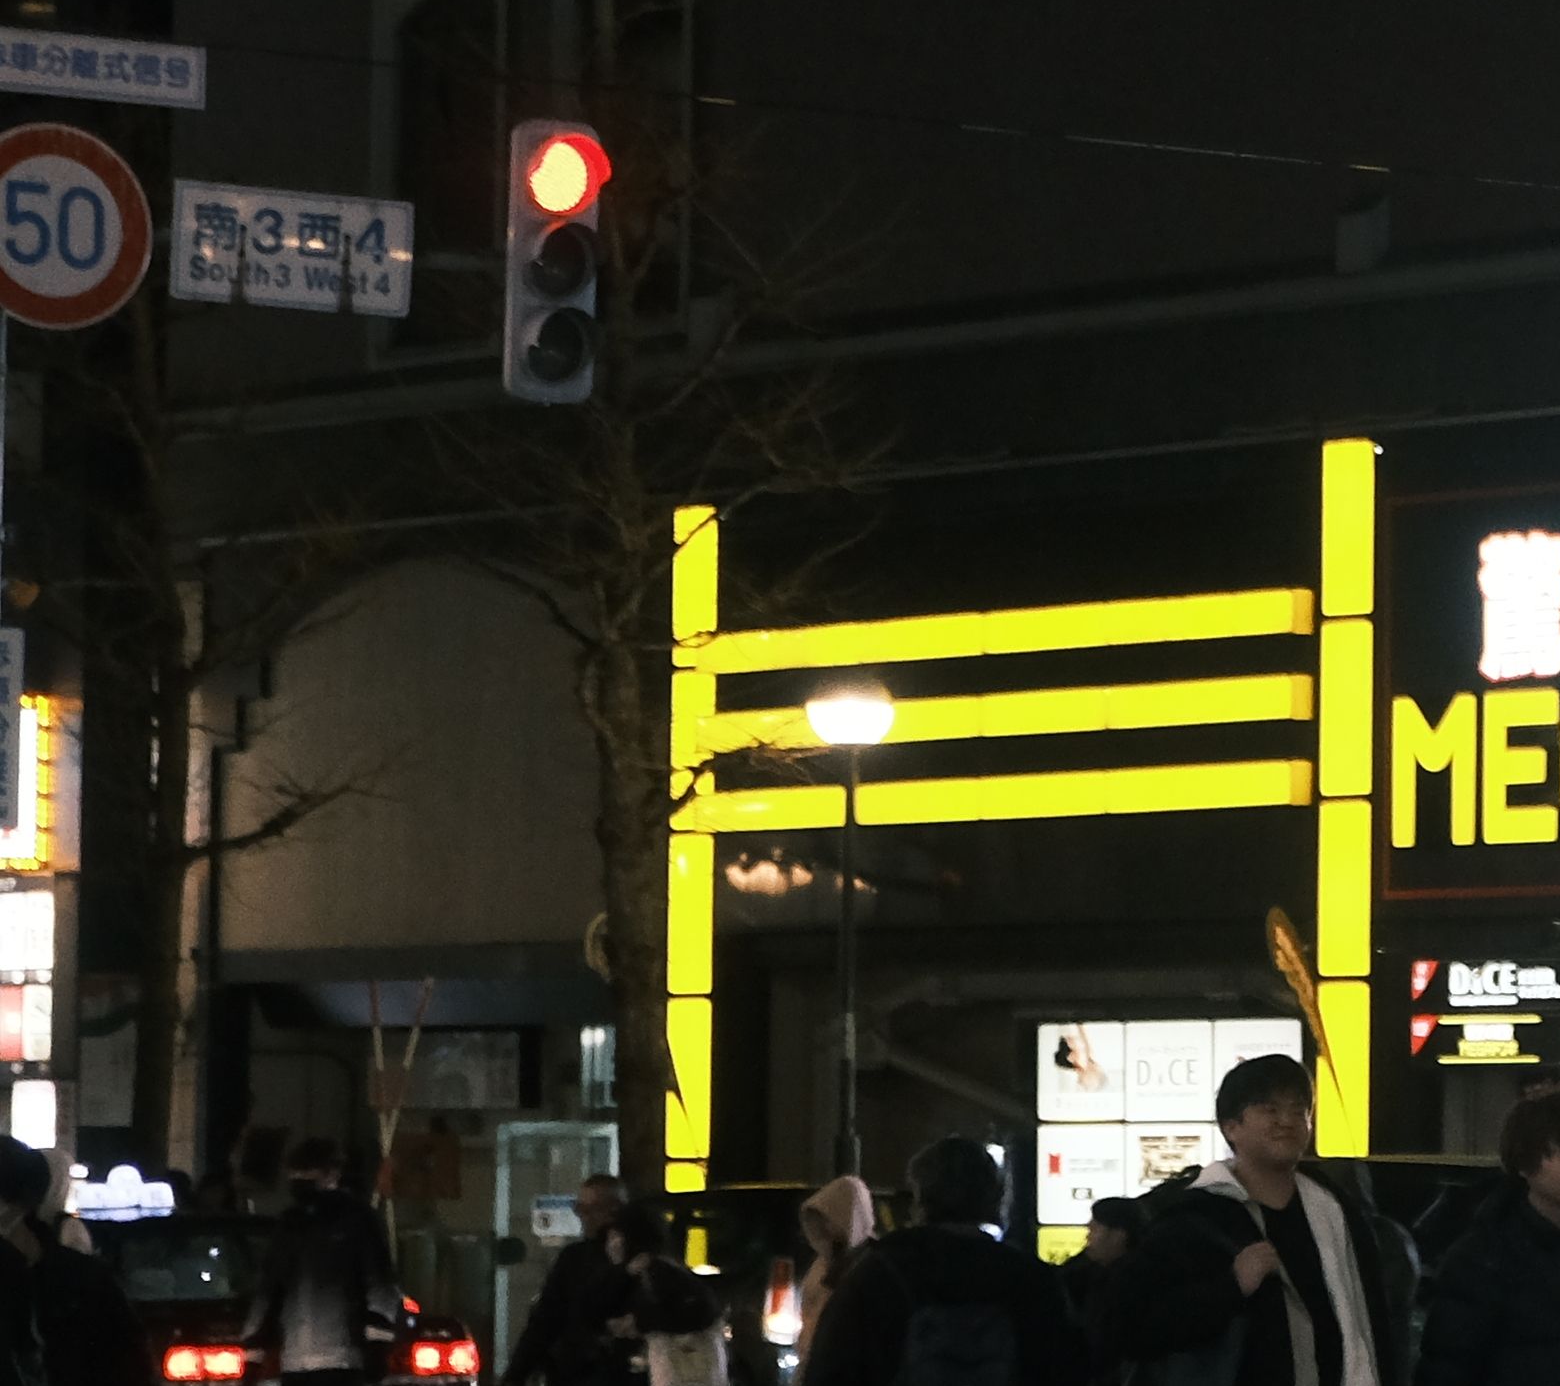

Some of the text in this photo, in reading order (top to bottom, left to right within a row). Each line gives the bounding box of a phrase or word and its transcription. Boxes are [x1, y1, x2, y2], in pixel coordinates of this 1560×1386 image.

[3, 180, 106, 270] 50
[194, 202, 386, 265] 南3西4
[273, 264, 291, 289] 3
[374, 272, 391, 296] 4
